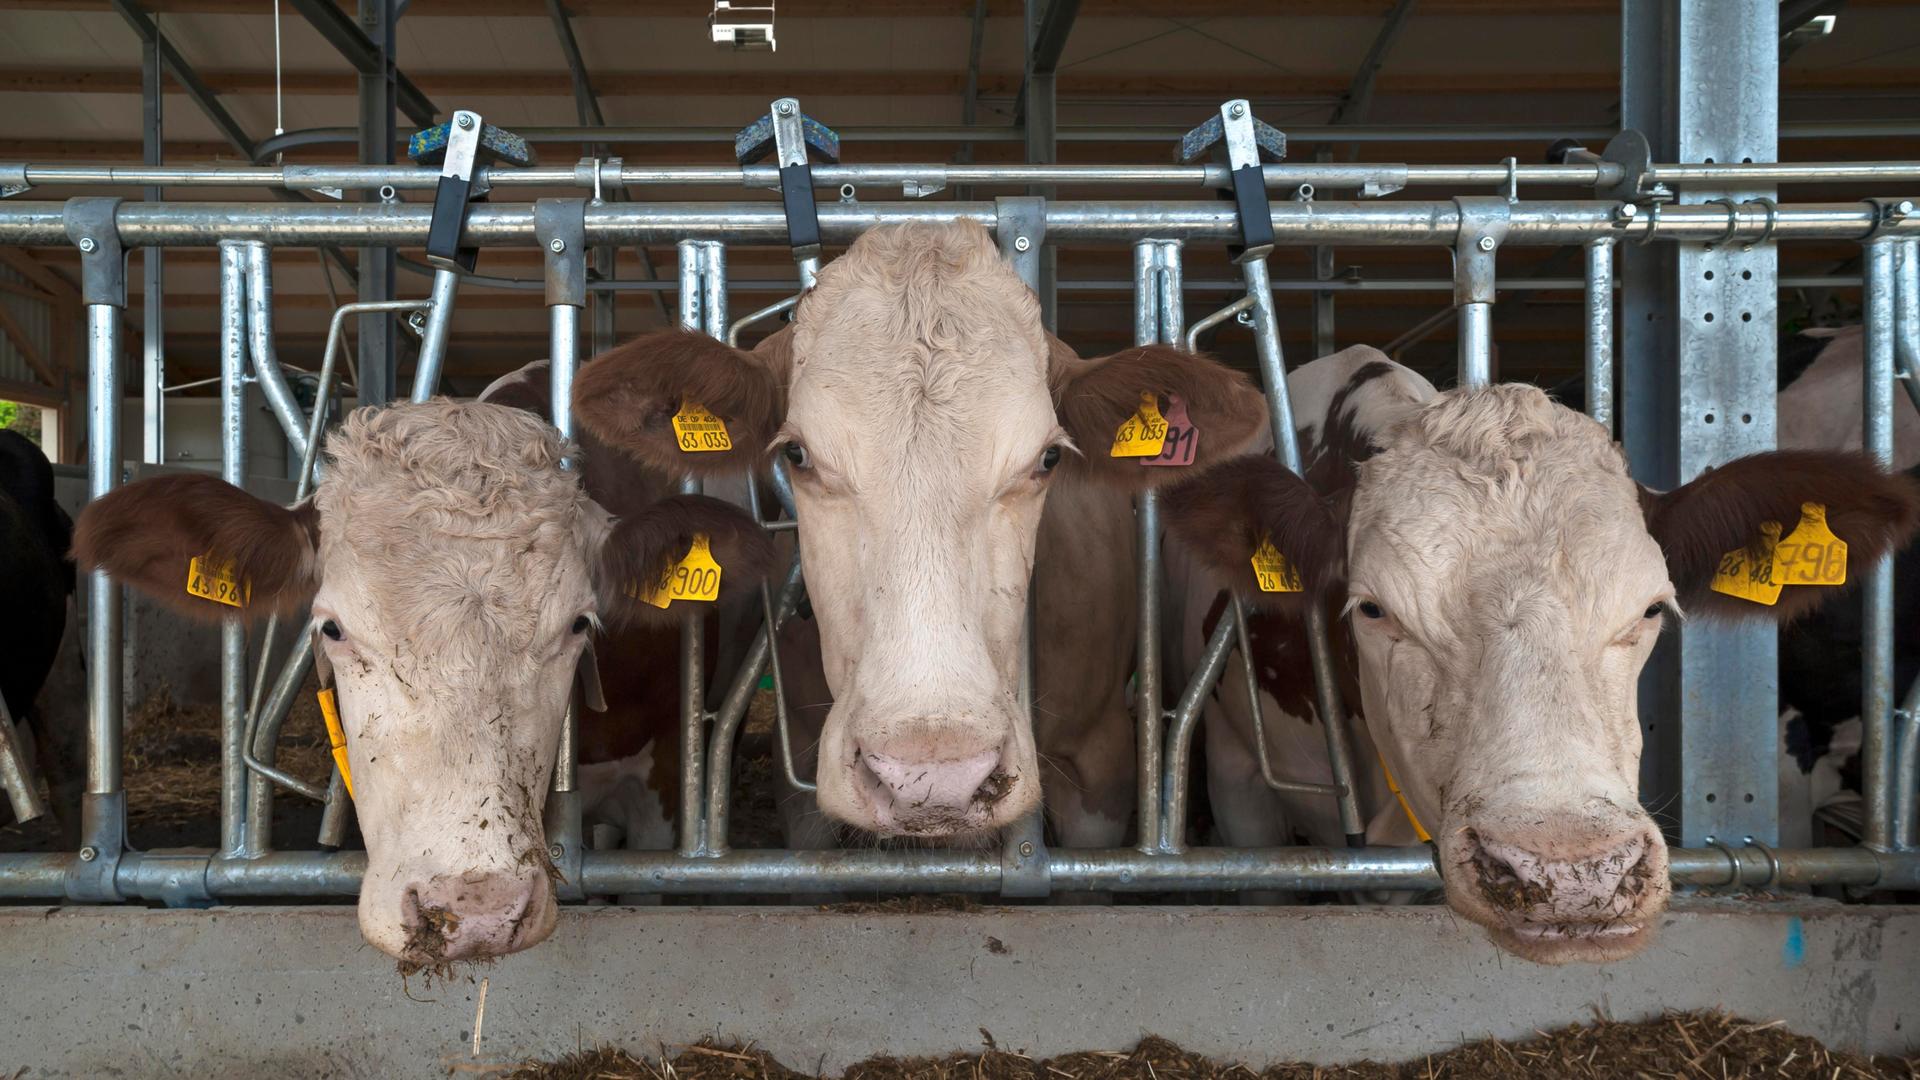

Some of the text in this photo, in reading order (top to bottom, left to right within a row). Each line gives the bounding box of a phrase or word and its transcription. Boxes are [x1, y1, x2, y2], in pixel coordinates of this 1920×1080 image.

[681, 431, 729, 449] 63 035
[1117, 422, 1167, 443] 63 035
[1146, 426, 1195, 463] 91
[1719, 555, 1745, 577] 26
[672, 566, 718, 596] 900
[1259, 572, 1275, 590] 26
